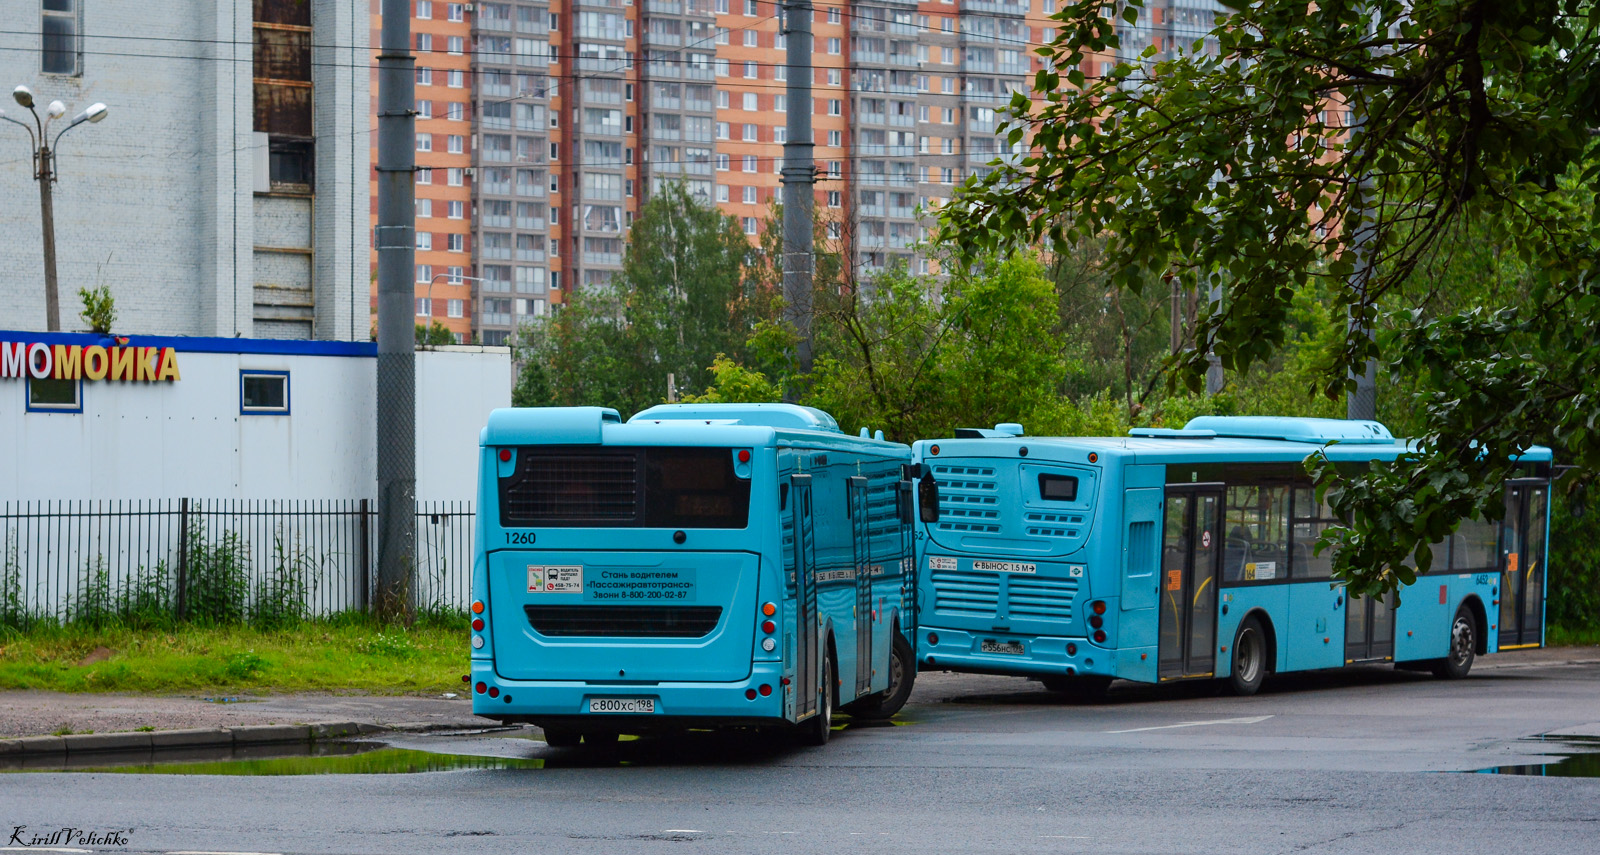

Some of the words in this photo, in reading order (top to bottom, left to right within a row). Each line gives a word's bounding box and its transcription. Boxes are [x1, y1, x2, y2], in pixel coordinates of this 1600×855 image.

[505, 532, 536, 544] 1260
[981, 562, 1009, 571] ВЫНОС
[601, 571, 629, 579] Стань
[630, 571, 679, 580] водителем
[1476, 574, 1489, 585] 6452
[593, 591, 620, 599] Звони
[621, 591, 688, 599] 8-800-200-02-87
[636, 700, 652, 708] 198
